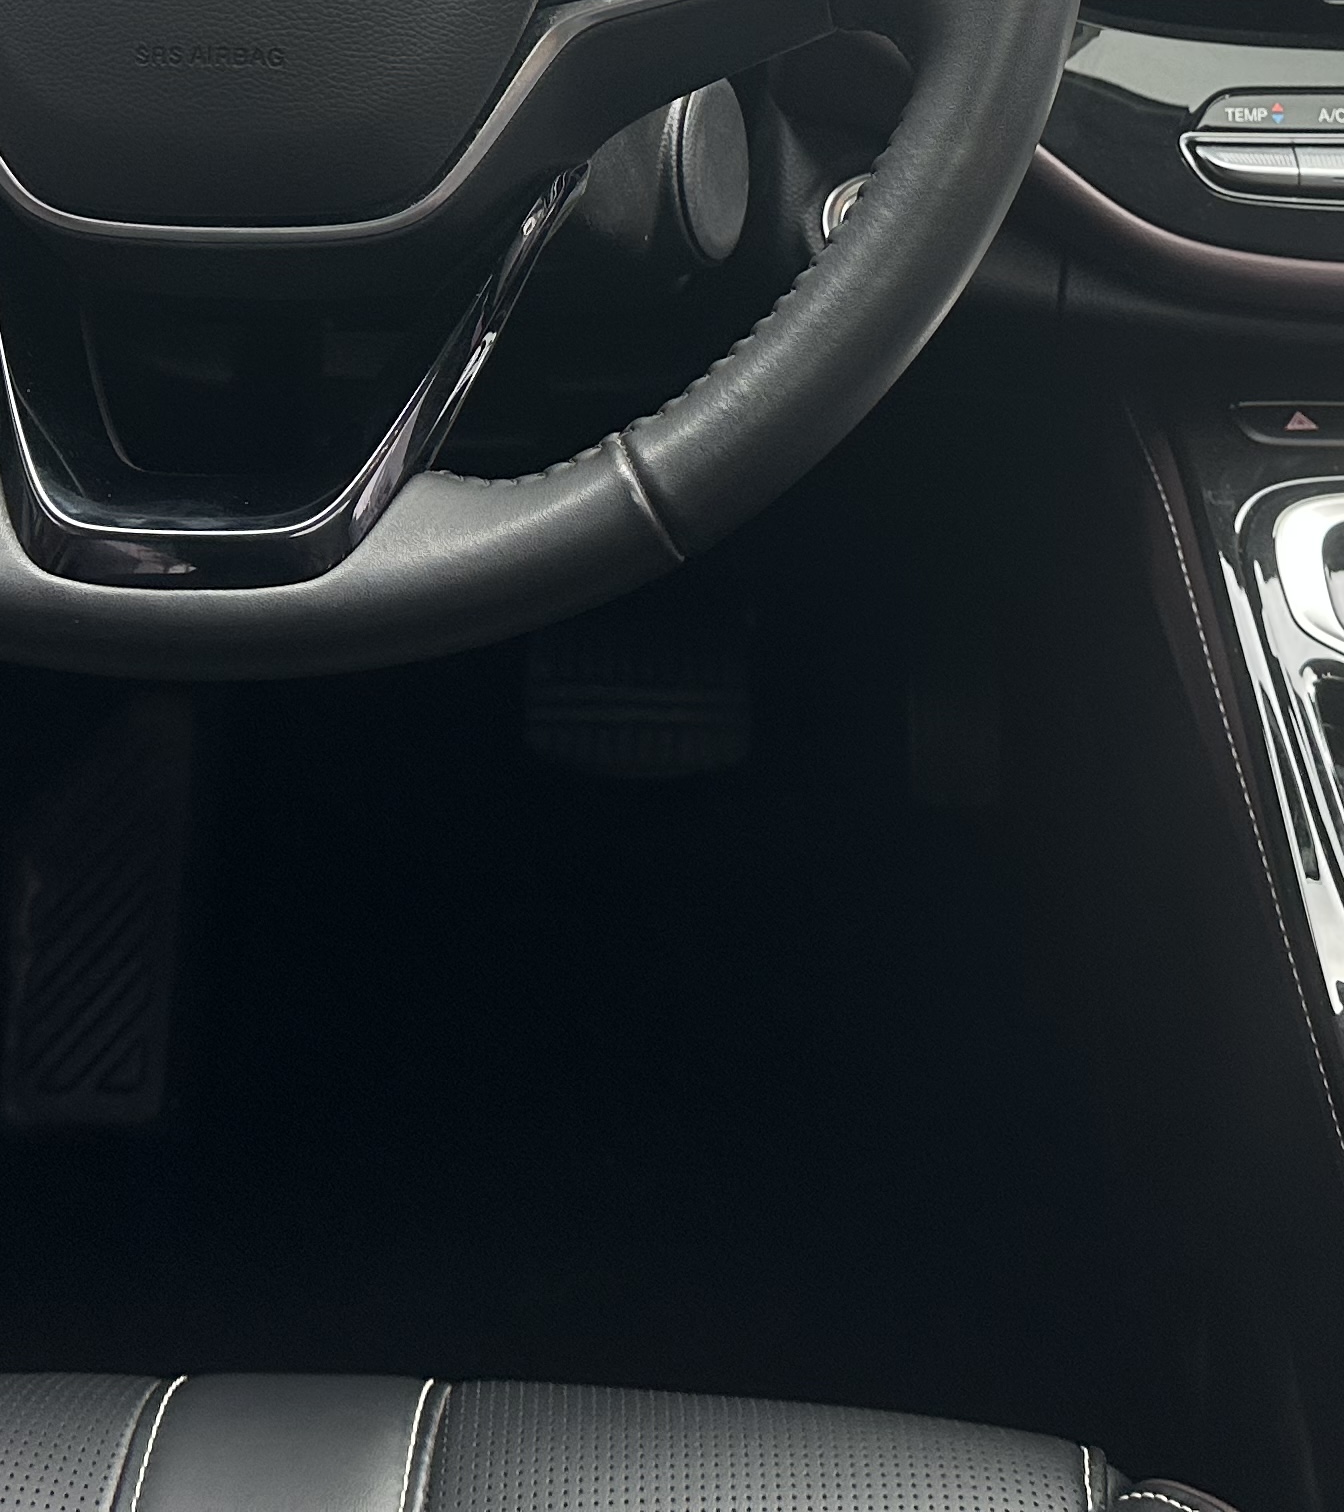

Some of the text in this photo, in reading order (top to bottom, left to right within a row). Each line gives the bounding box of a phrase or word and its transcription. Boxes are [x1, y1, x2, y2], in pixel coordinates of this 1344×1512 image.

[135, 43, 286, 70] SRS AIRBAG
[1225, 107, 1269, 123] TEMP
